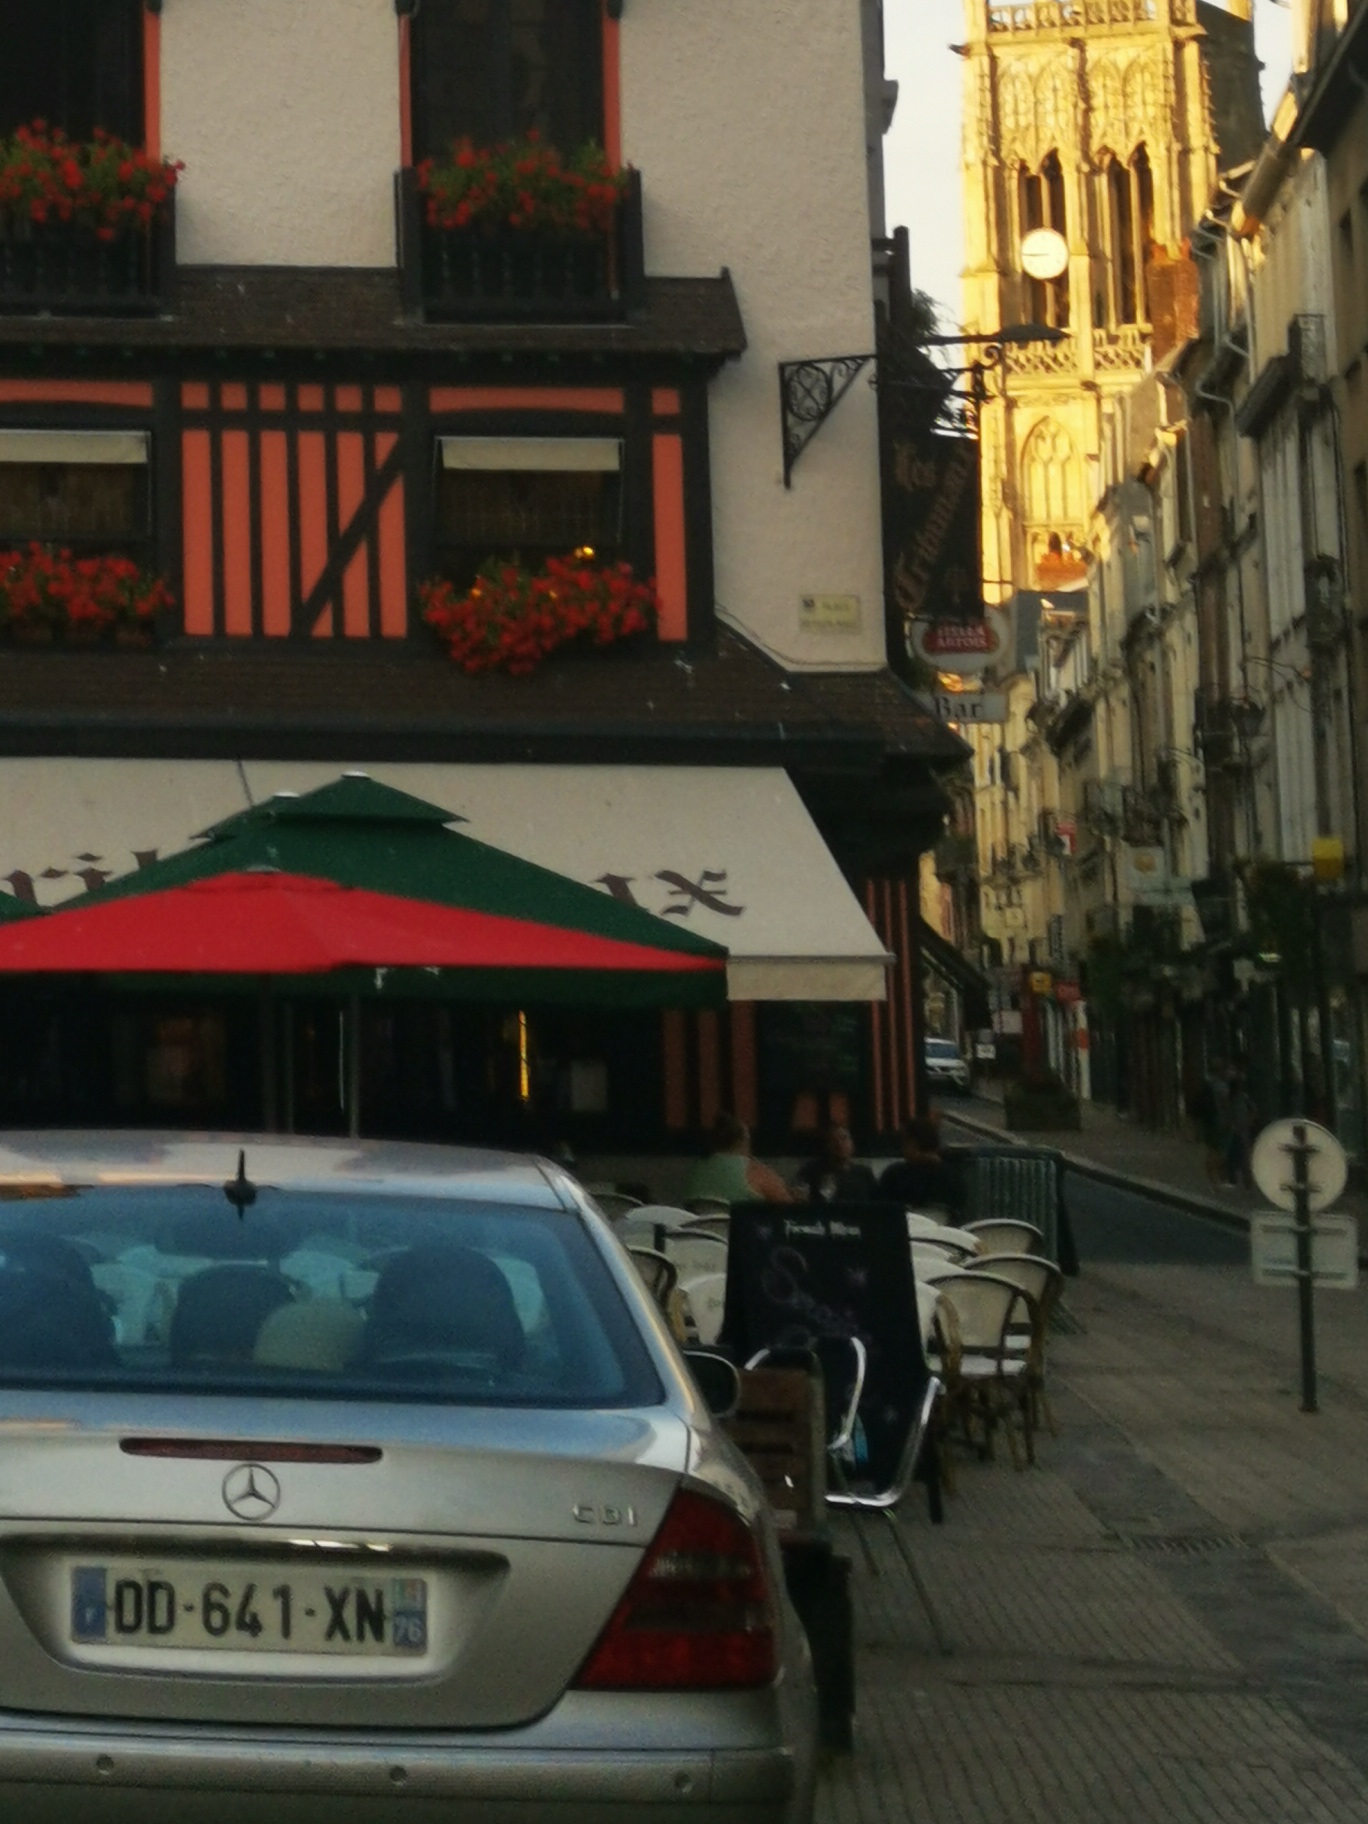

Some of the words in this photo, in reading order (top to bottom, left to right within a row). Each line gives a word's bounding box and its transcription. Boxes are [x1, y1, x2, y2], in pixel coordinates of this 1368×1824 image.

[935, 695, 983, 720] Bar
[572, 1502, 639, 1527] CDI
[393, 1616, 425, 1643] 76
